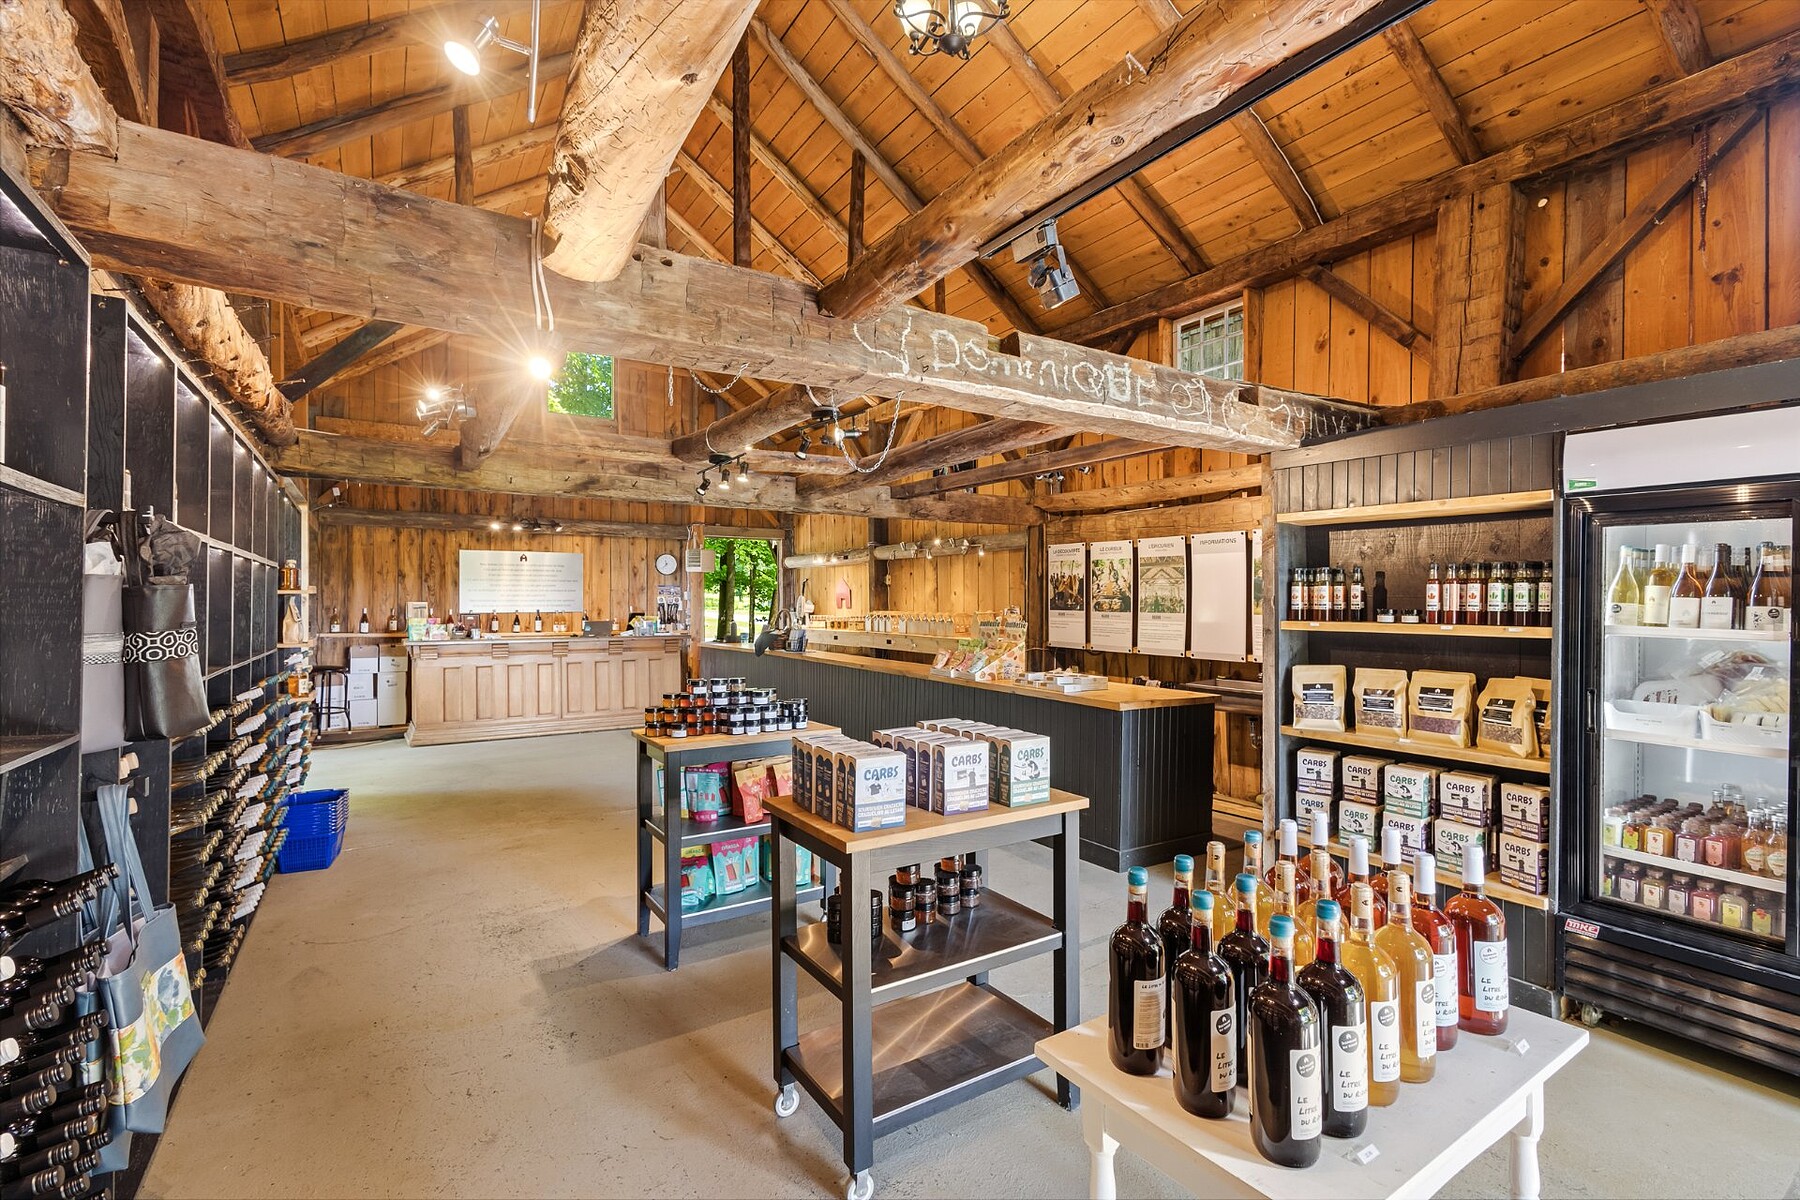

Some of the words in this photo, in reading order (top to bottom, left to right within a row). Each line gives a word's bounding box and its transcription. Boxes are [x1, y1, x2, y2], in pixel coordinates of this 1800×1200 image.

[1200, 537, 1237, 546] INFORMATIONS
[1017, 746, 1044, 760] CARBS
[952, 752, 982, 768] CARBS
[1302, 758, 1327, 768] CARBS
[864, 766, 899, 781] CARBS
[1347, 766, 1372, 776] CARBS
[1390, 774, 1417, 786] CARBS
[1446, 782, 1476, 794] CARBS
[1300, 798, 1324, 808] CARBS
[1506, 792, 1533, 805] CARBS
[1344, 810, 1369, 820] CARBS
[1388, 820, 1415, 832] CARBS
[1440, 830, 1470, 842] CARBS
[1504, 842, 1531, 857] CARBS
[1340, 1070, 1351, 1078] LE
[1297, 1096, 1308, 1104] LE
